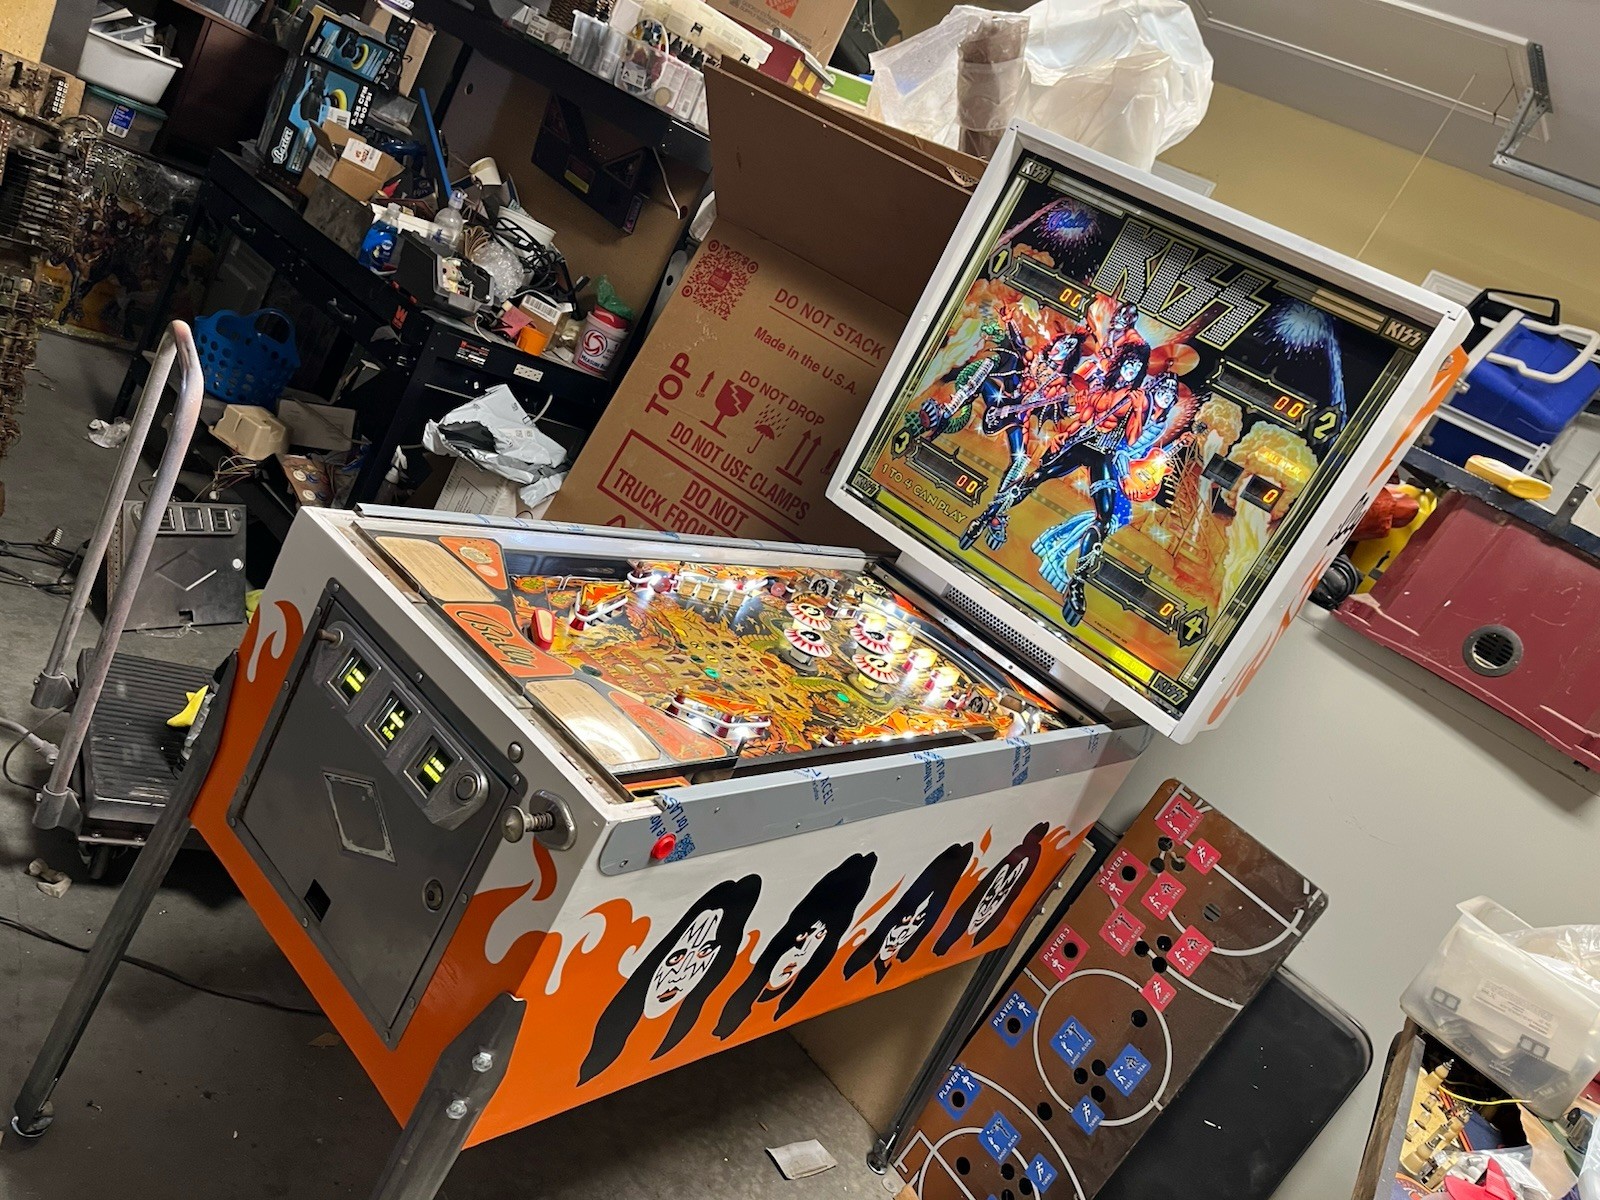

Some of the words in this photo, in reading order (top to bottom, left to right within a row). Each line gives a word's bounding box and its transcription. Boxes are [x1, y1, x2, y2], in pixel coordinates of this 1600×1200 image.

[351, 105, 361, 126] 2.35
[358, 85, 369, 104] CFM
[1020, 160, 1050, 182] KISS
[994, 250, 1008, 273] 1
[1091, 216, 1271, 351] KISS
[774, 288, 799, 310] DO
[800, 302, 835, 329] NOT
[833, 322, 886, 360] STACK
[1384, 320, 1423, 347] KISS
[754, 326, 786, 352] Made
[786, 345, 799, 361] in
[800, 354, 820, 373] the
[822, 366, 857, 396] U.S.A.
[644, 352, 692, 416] TOP
[739, 370, 760, 389] DO
[759, 382, 791, 406] NOT
[787, 399, 826, 428] DROP
[1274, 395, 1305, 419] 00
[1313, 411, 1337, 440] 2
[895, 431, 911, 454] 3
[669, 421, 693, 446] DO
[691, 433, 724, 464] NOT
[721, 452, 753, 483] USE
[749, 469, 811, 521] CLAMPS
[956, 474, 979, 494] 00
[612, 468, 668, 518] TRUCK
[682, 480, 710, 508] DO
[708, 494, 749, 532] NOT
[882, 463, 889, 474] 1
[890, 468, 904, 483] TO
[904, 479, 914, 490] 4
[913, 484, 938, 506] CAN
[937, 500, 968, 524] PLAY
[1262, 488, 1279, 504] 0
[1159, 602, 1174, 616] 0
[453, 608, 538, 668] Bally
[1184, 615, 1203, 640] 4
[1153, 676, 1184, 700] KISS
[1100, 855, 1124, 885] PLAYER
[1043, 933, 1066, 961] PLAYER
[992, 998, 1017, 1027] PLAYER
[938, 1070, 961, 1101] PLAYER
